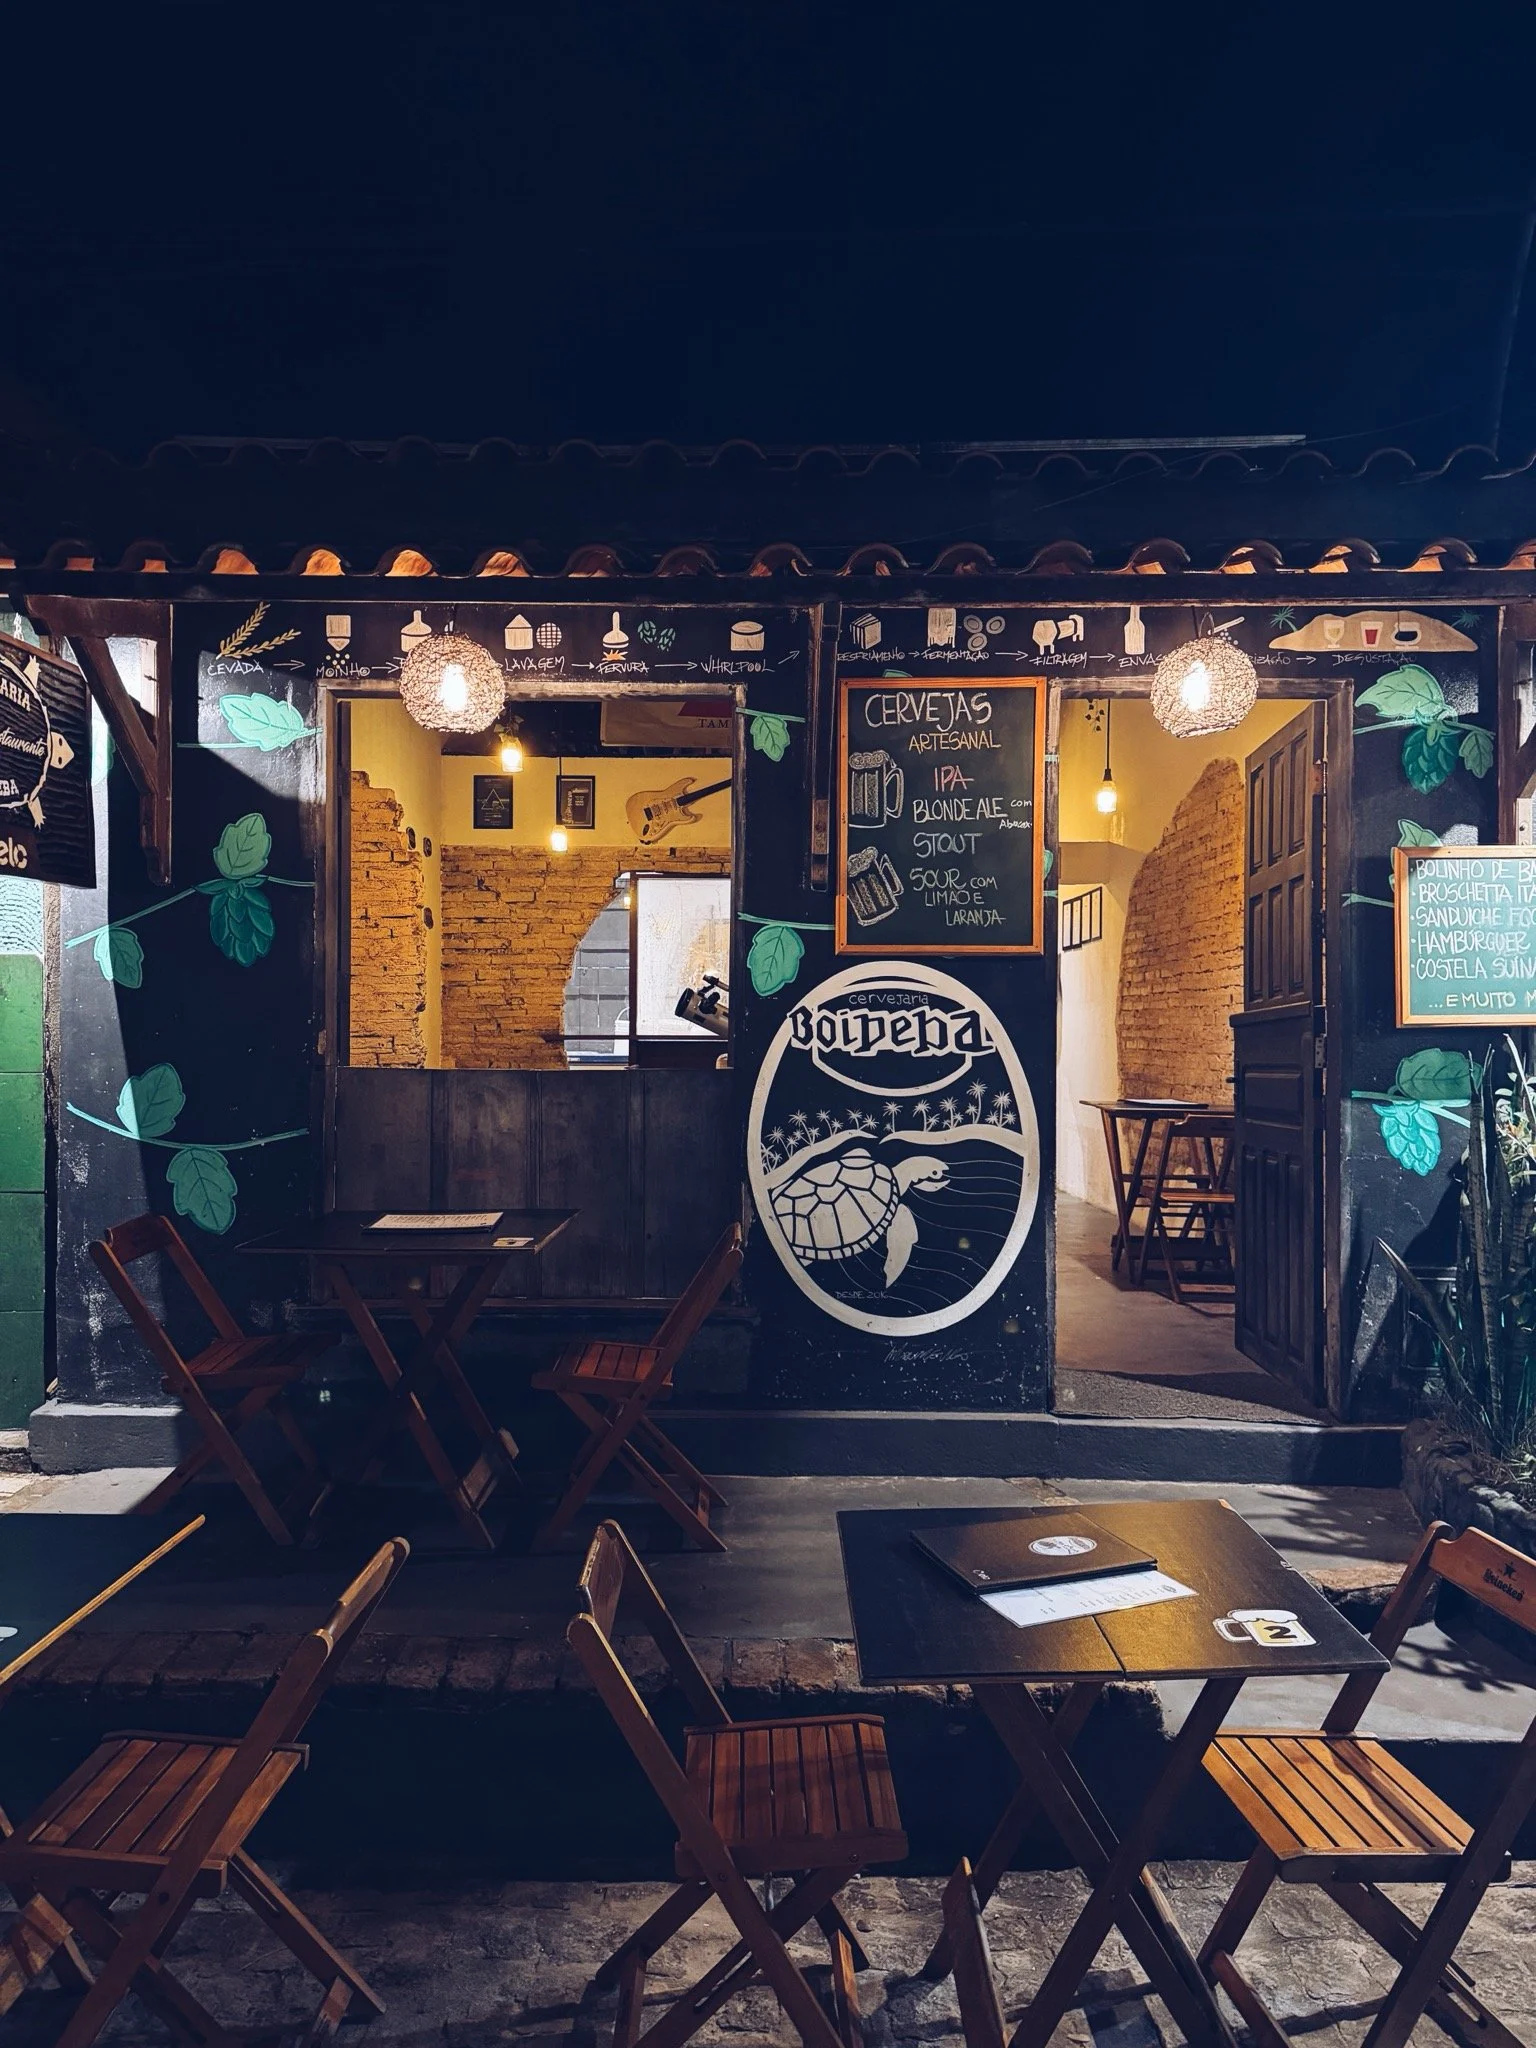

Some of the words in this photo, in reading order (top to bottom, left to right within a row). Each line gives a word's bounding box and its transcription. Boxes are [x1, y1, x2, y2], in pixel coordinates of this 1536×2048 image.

[207, 660, 264, 676] CEVADA
[316, 662, 371, 678] MOINHO
[505, 655, 565, 672] LAVAGEM
[596, 661, 649, 674] FERVURA
[701, 655, 775, 674] WHIRLPOOL
[837, 646, 905, 662] RESFRIAMENTO
[1029, 652, 1087, 668] FILTRAGEM
[1118, 653, 1163, 668] ENVAS
[0, 678, 31, 712] ARIA
[865, 691, 992, 732] CERVEJAS
[908, 731, 1001, 754] ARTESANAL
[934, 765, 974, 792] IPA
[913, 798, 974, 823] BLONDE
[976, 797, 1008, 819] ALE
[913, 832, 982, 859] STOUT
[909, 868, 966, 891] SOUR
[1416, 860, 1484, 880] BOLINHO
[1492, 860, 1516, 881] DE
[973, 892, 985, 905] E
[1419, 882, 1512, 904] BRUSCHETTA
[946, 909, 1006, 927] LARANJA
[1416, 907, 1502, 929] SANDUICHE
[1416, 957, 1487, 980] COSTELA
[1462, 991, 1516, 1009] MUITO
[1483, 1567, 1525, 1602] Heineken
[1264, 1625, 1298, 1639] 2
